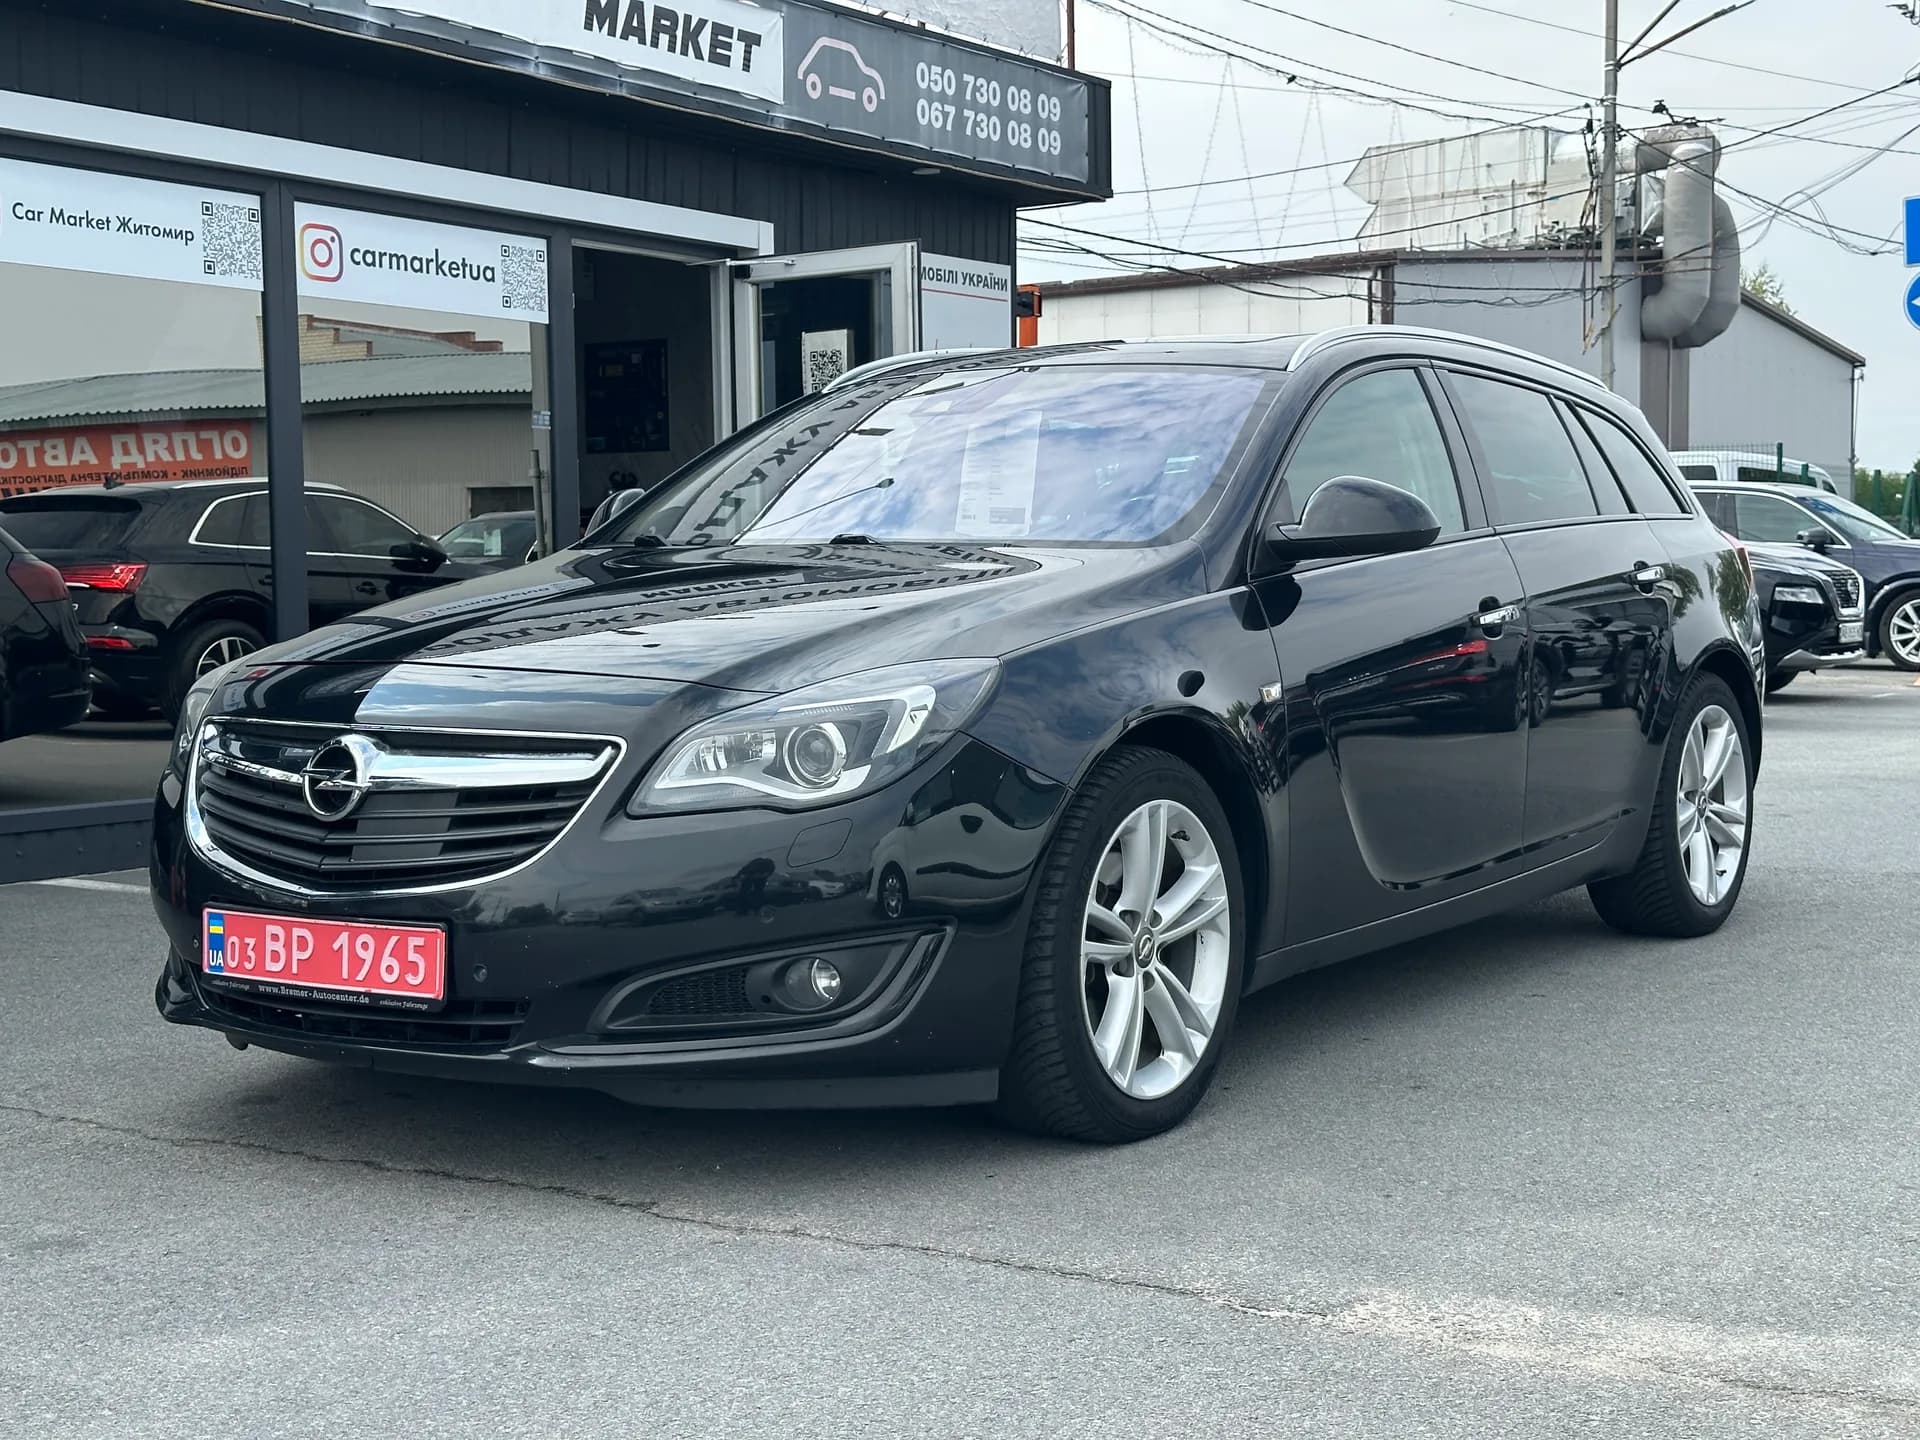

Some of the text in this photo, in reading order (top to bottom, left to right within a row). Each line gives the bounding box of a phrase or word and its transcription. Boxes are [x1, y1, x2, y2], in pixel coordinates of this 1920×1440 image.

[583, 0, 762, 73] MARKET
[916, 62, 1061, 122] 050 730 08 09
[916, 98, 1061, 156] 067 730 08 09
[12, 202, 195, 246] Car Market Житомир
[350, 247, 496, 283] carmarketua
[961, 271, 1008, 292] УКРАЇНИ
[209, 950, 224, 967] UA
[226, 924, 425, 986] 03 BP 1965
